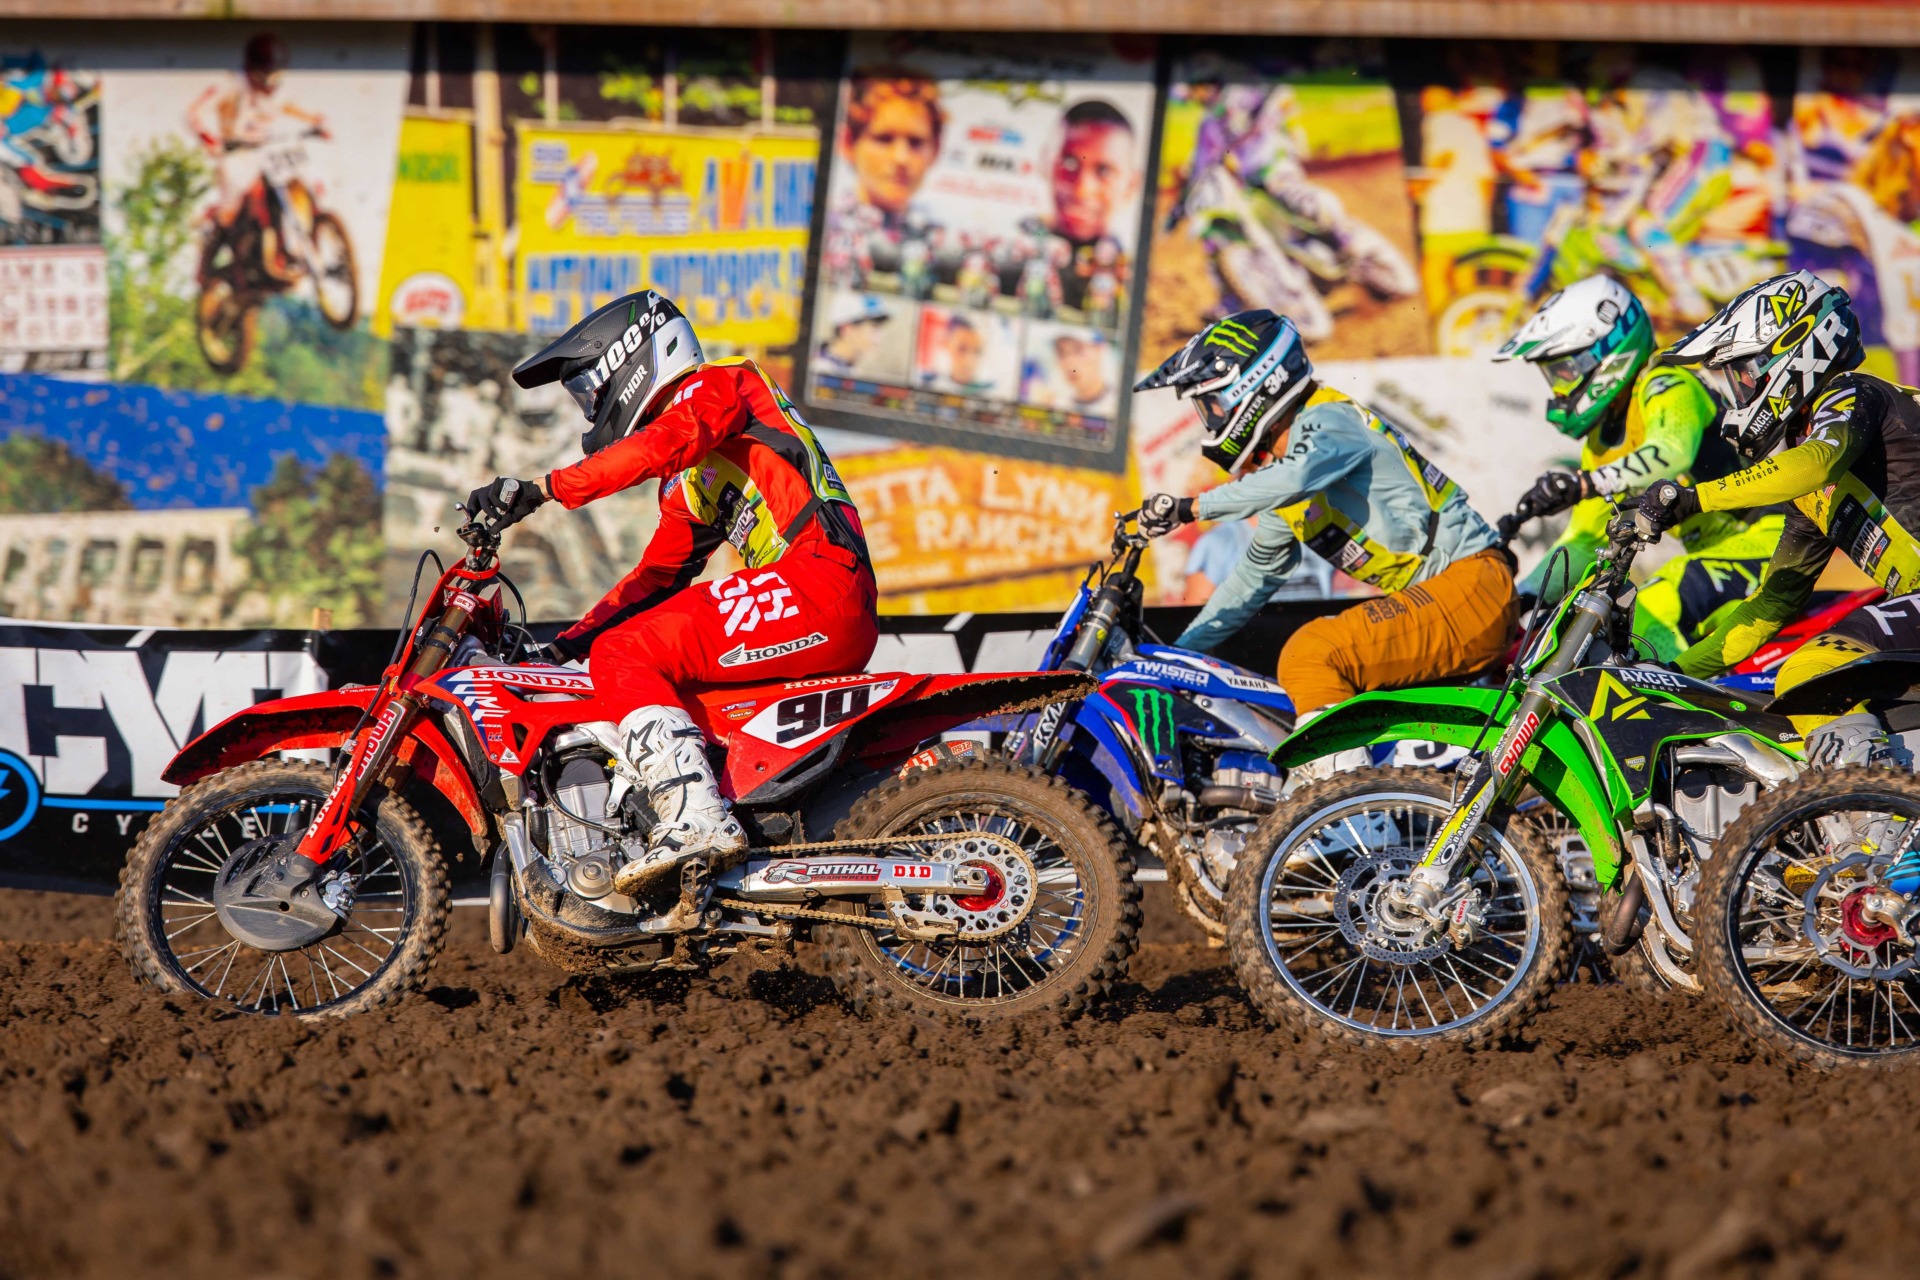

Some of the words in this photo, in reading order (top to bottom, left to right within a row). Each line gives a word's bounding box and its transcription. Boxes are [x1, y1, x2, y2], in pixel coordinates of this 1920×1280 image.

[595, 303, 666, 383] 100%
[618, 364, 649, 406] THOR
[1231, 354, 1277, 399] OAKLEY
[1263, 364, 1290, 396] 34
[1229, 394, 1266, 441] MONSTER
[1749, 408, 1774, 436] AXCEL
[1735, 464, 1780, 487] DIVISION
[456, 598, 474, 609] GET
[745, 632, 826, 662] HONDA
[471, 669, 593, 689] HONDA
[783, 674, 876, 690] HONDA
[1134, 660, 1211, 686] TWISTED
[1226, 675, 1270, 691] YAMAHA
[1618, 669, 1687, 689] AXCEL
[1635, 682, 1681, 693] ENERGY
[776, 685, 872, 744] 90
[1499, 711, 1540, 777] SHOWA
[306, 758, 355, 838] DUNLOP
[1453, 802, 1480, 845] OAKLEY
[776, 861, 880, 883] RENTHAL
